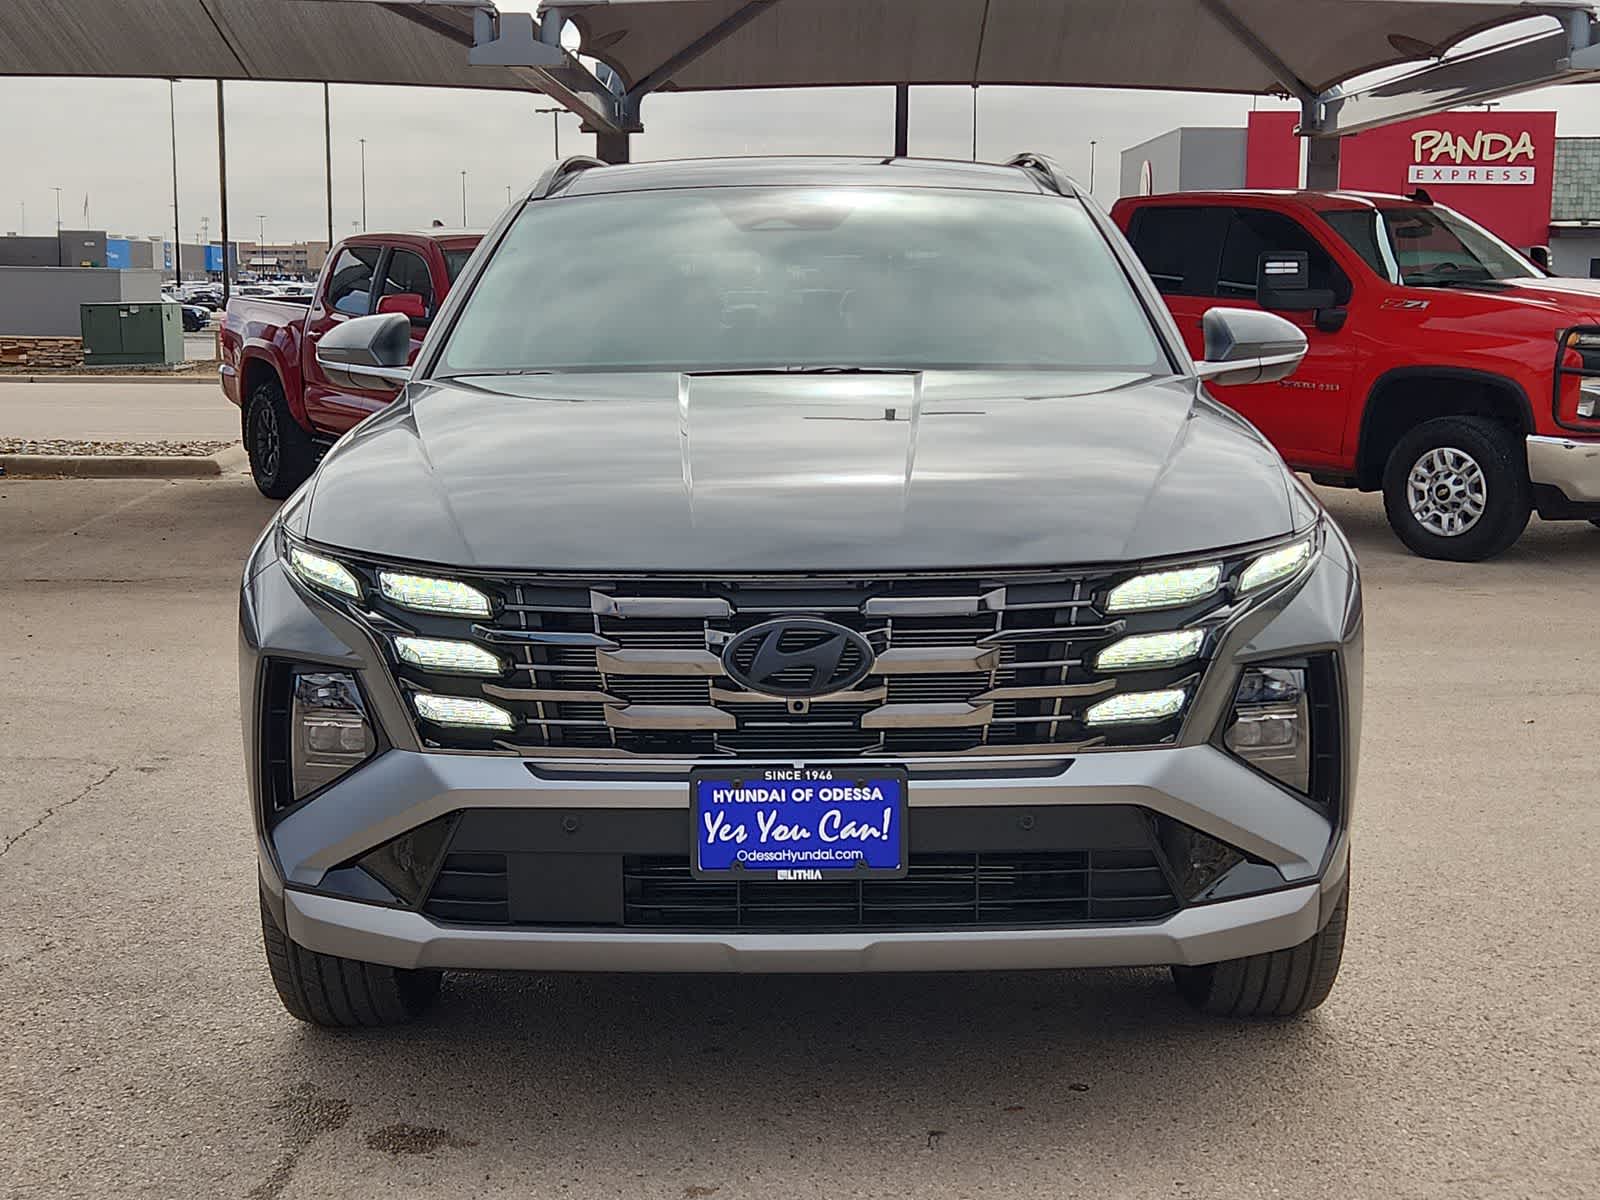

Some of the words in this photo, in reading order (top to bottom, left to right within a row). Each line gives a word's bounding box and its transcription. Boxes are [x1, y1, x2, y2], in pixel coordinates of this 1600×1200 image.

[1411, 129, 1535, 164] PANDA
[1416, 169, 1528, 181] EXPRESS
[764, 770, 801, 781] SINCE
[804, 770, 833, 780] 1946
[713, 788, 786, 803] HYUNDAI
[791, 788, 814, 802] OF
[818, 787, 884, 802] ODESSA
[703, 810, 748, 844] Yes
[756, 809, 811, 843] You
[817, 807, 892, 842] Can!
[736, 849, 863, 863] OdessaHyundai.com
[788, 870, 822, 880] LITHIA
